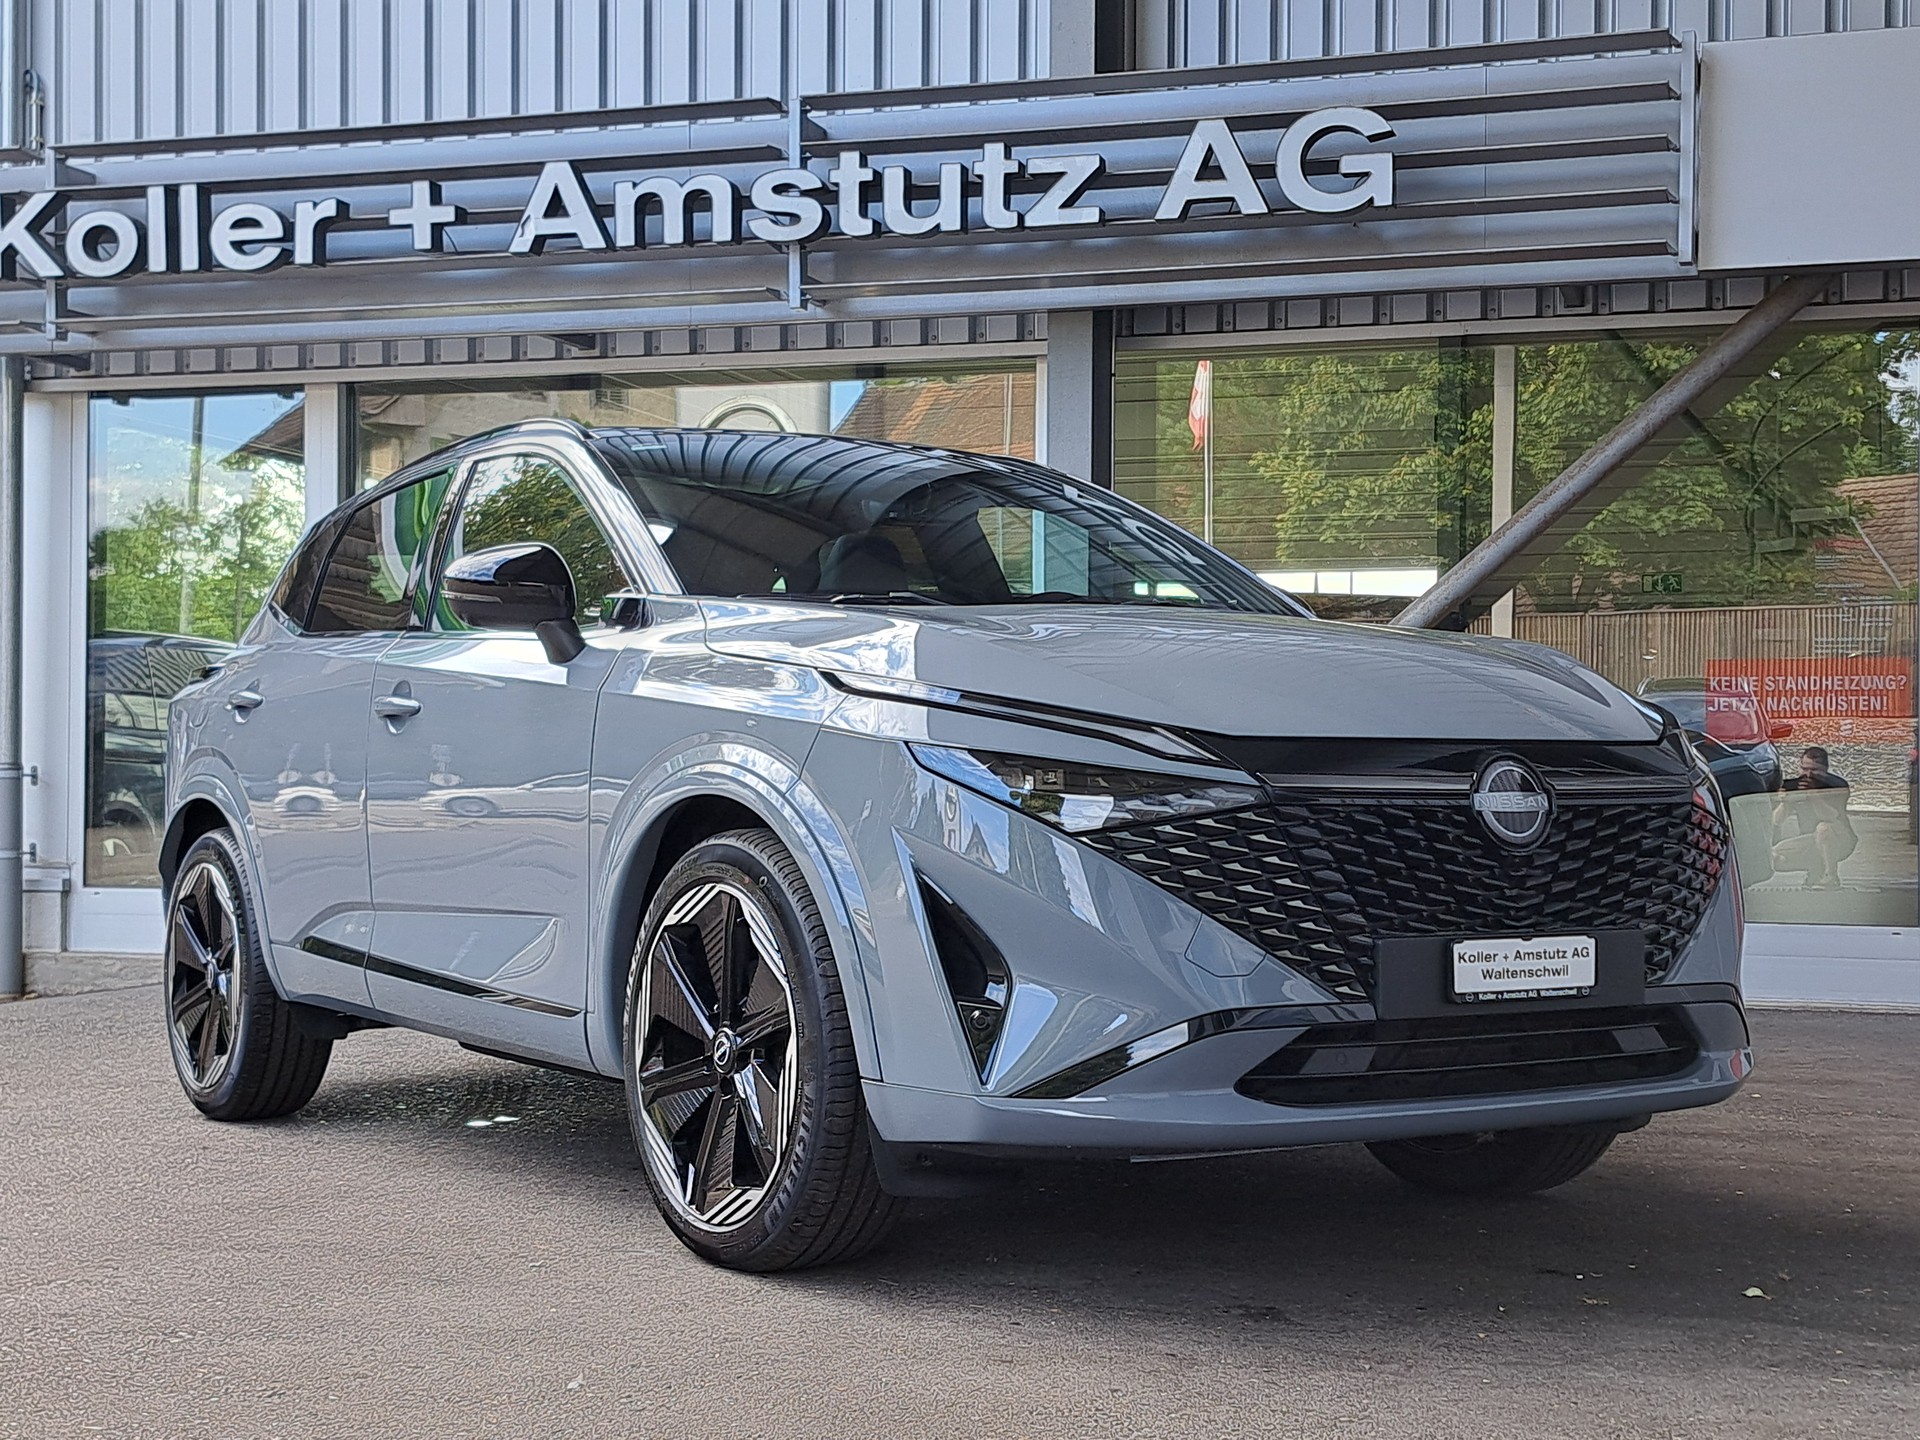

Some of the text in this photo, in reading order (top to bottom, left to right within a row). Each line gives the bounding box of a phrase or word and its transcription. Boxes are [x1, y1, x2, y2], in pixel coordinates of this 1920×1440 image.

[0, 106, 1398, 279] Koller + Amstutz AG
[1709, 675, 1908, 691] KEINE STANDHEIZUNG?
[1707, 694, 1888, 712] JETZT NACHRÜSTEN!
[1476, 796, 1548, 808] NISSAN
[1457, 952, 1499, 964] Koller
[1513, 948, 1568, 962] Amstutz
[1571, 946, 1590, 959] AG
[1481, 964, 1569, 981] Waltenschwil
